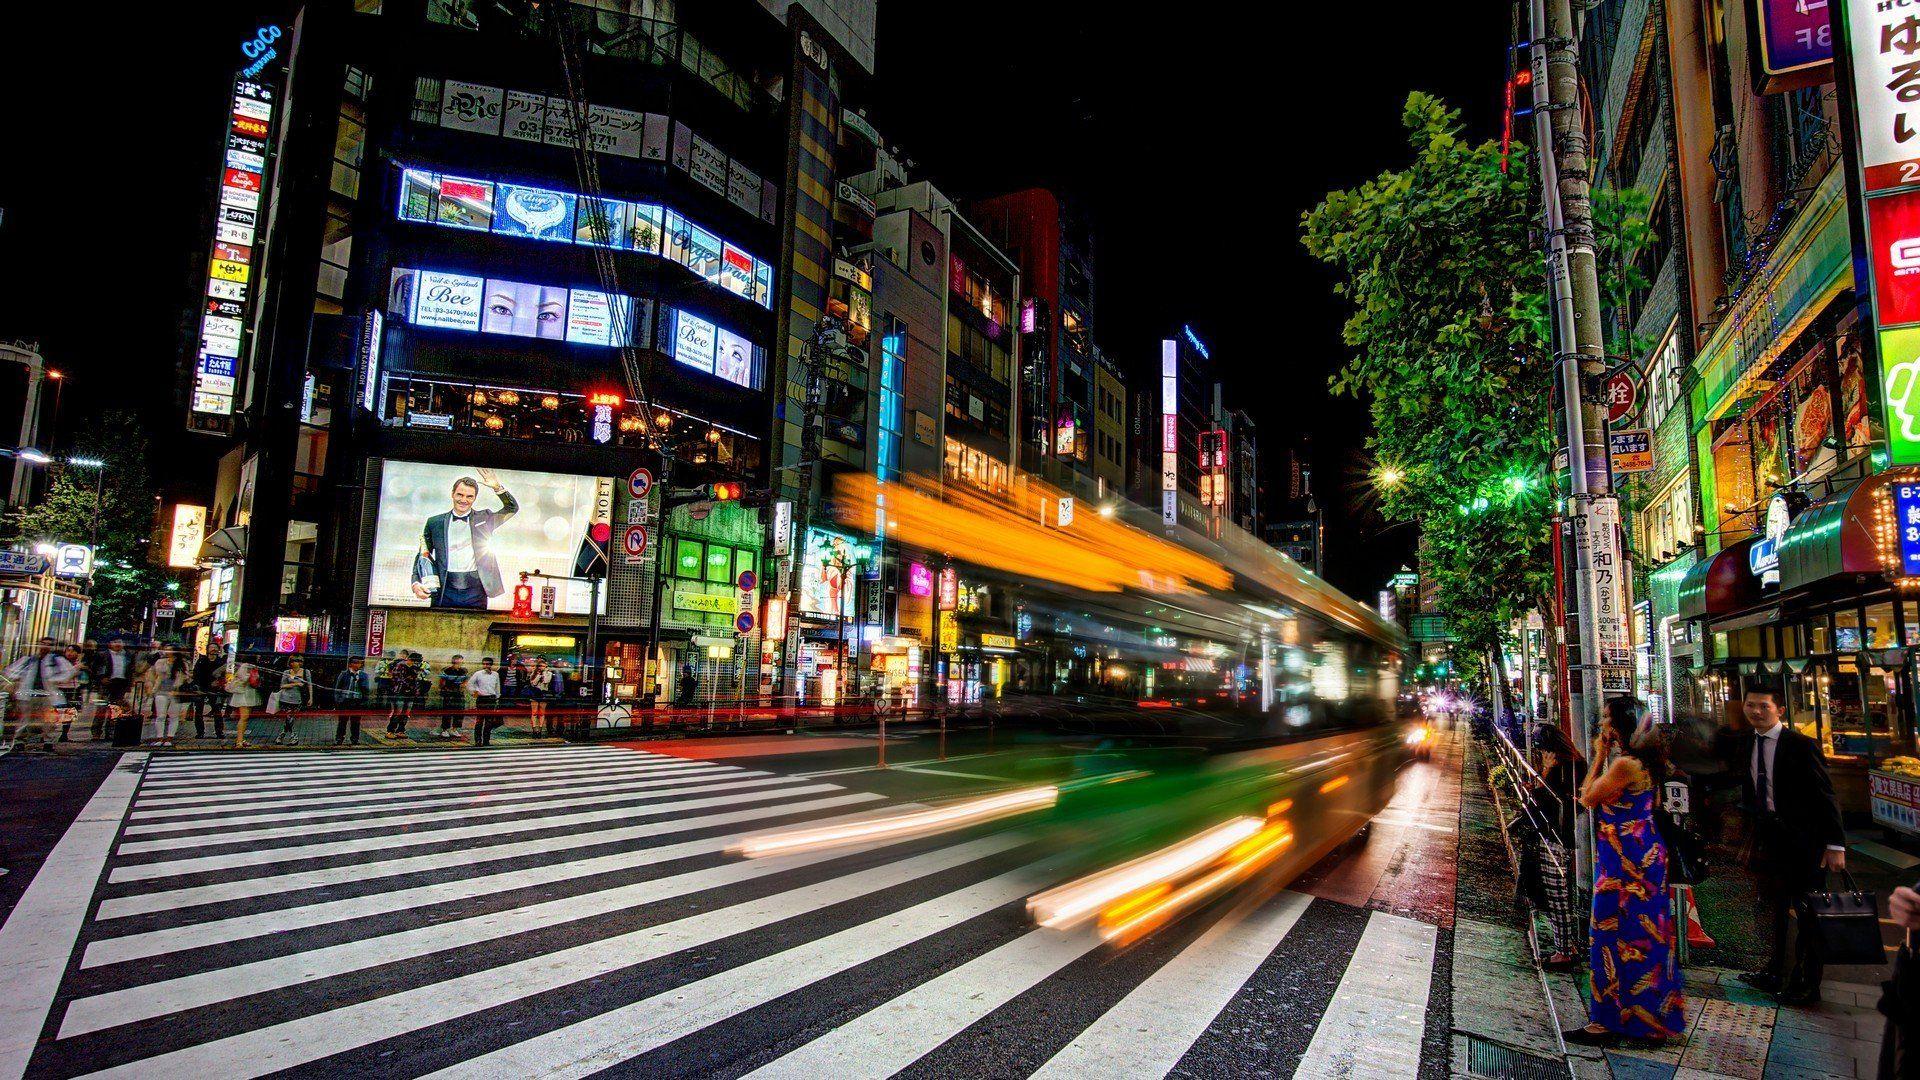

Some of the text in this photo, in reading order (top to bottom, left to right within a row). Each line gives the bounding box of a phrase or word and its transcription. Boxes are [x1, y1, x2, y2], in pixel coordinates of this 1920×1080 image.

[242, 25, 282, 58] CoCo
[508, 98, 643, 131] アリア六本クリニック
[426, 286, 474, 305] Bee
[679, 325, 709, 348] Bee
[1592, 551, 1613, 585] 和乃
